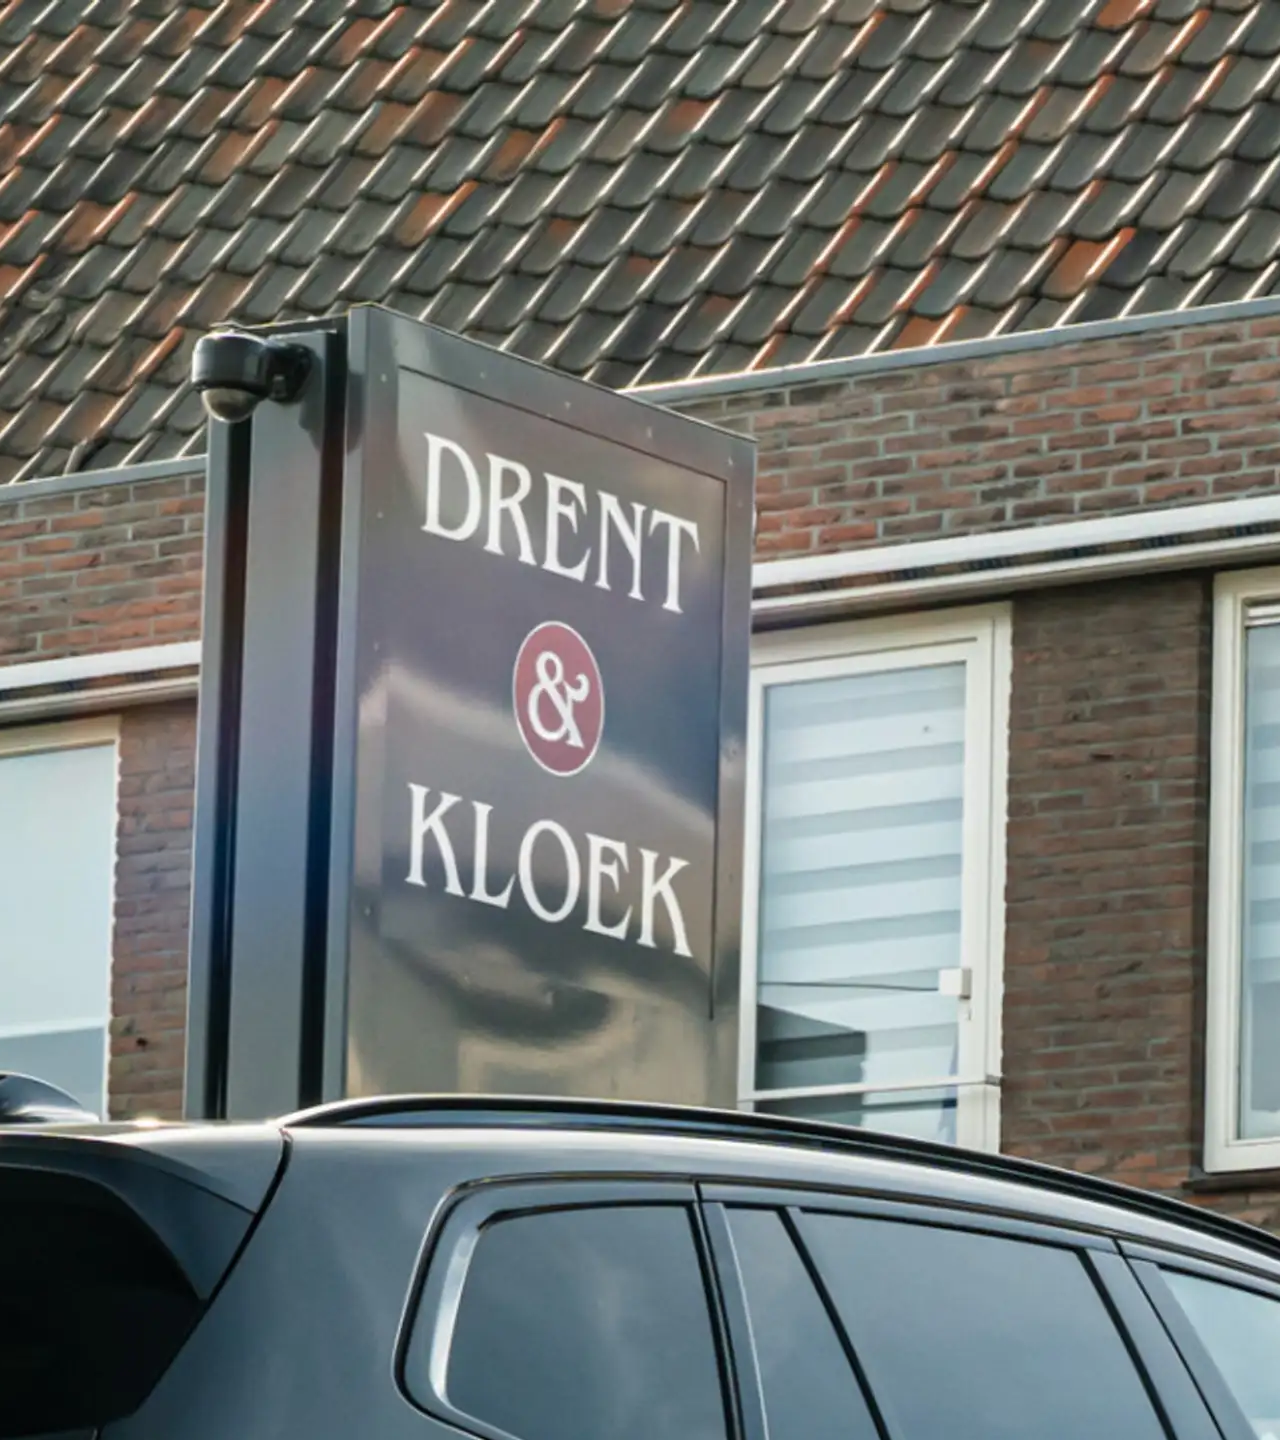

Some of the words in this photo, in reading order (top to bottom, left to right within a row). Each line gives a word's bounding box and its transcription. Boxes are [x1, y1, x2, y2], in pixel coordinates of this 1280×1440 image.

[420, 431, 700, 614] DRENT
[527, 650, 589, 749] &
[405, 782, 694, 958] KLOEK
